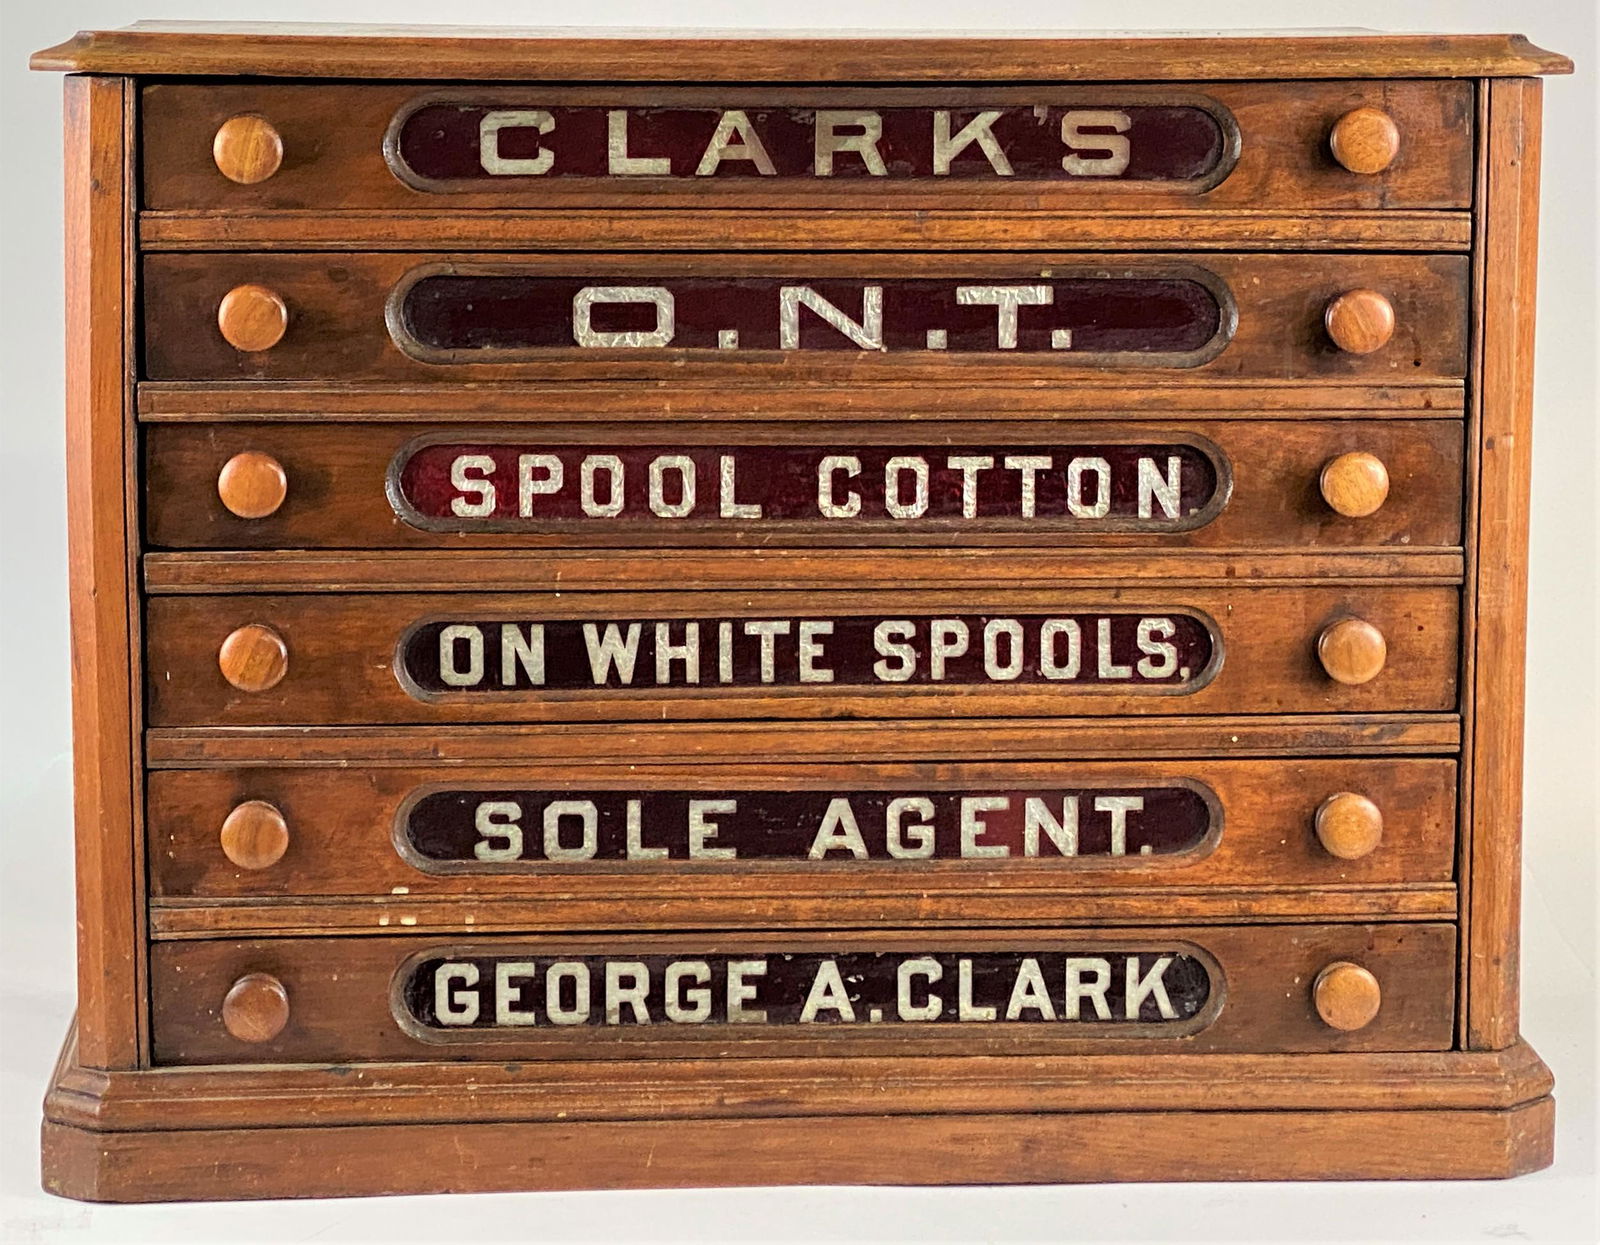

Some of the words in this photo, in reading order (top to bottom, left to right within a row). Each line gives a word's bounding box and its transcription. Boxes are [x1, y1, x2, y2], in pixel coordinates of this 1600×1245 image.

[480, 104, 1132, 176] CLARK'S
[573, 285, 1073, 350] O.N.T.
[451, 454, 763, 519] SPOOL
[439, 624, 546, 686] ON
[583, 620, 835, 685] WHITE
[474, 799, 738, 863] SOLE
[808, 796, 1153, 860] AGENT.
[435, 960, 768, 1025] GEORGE
